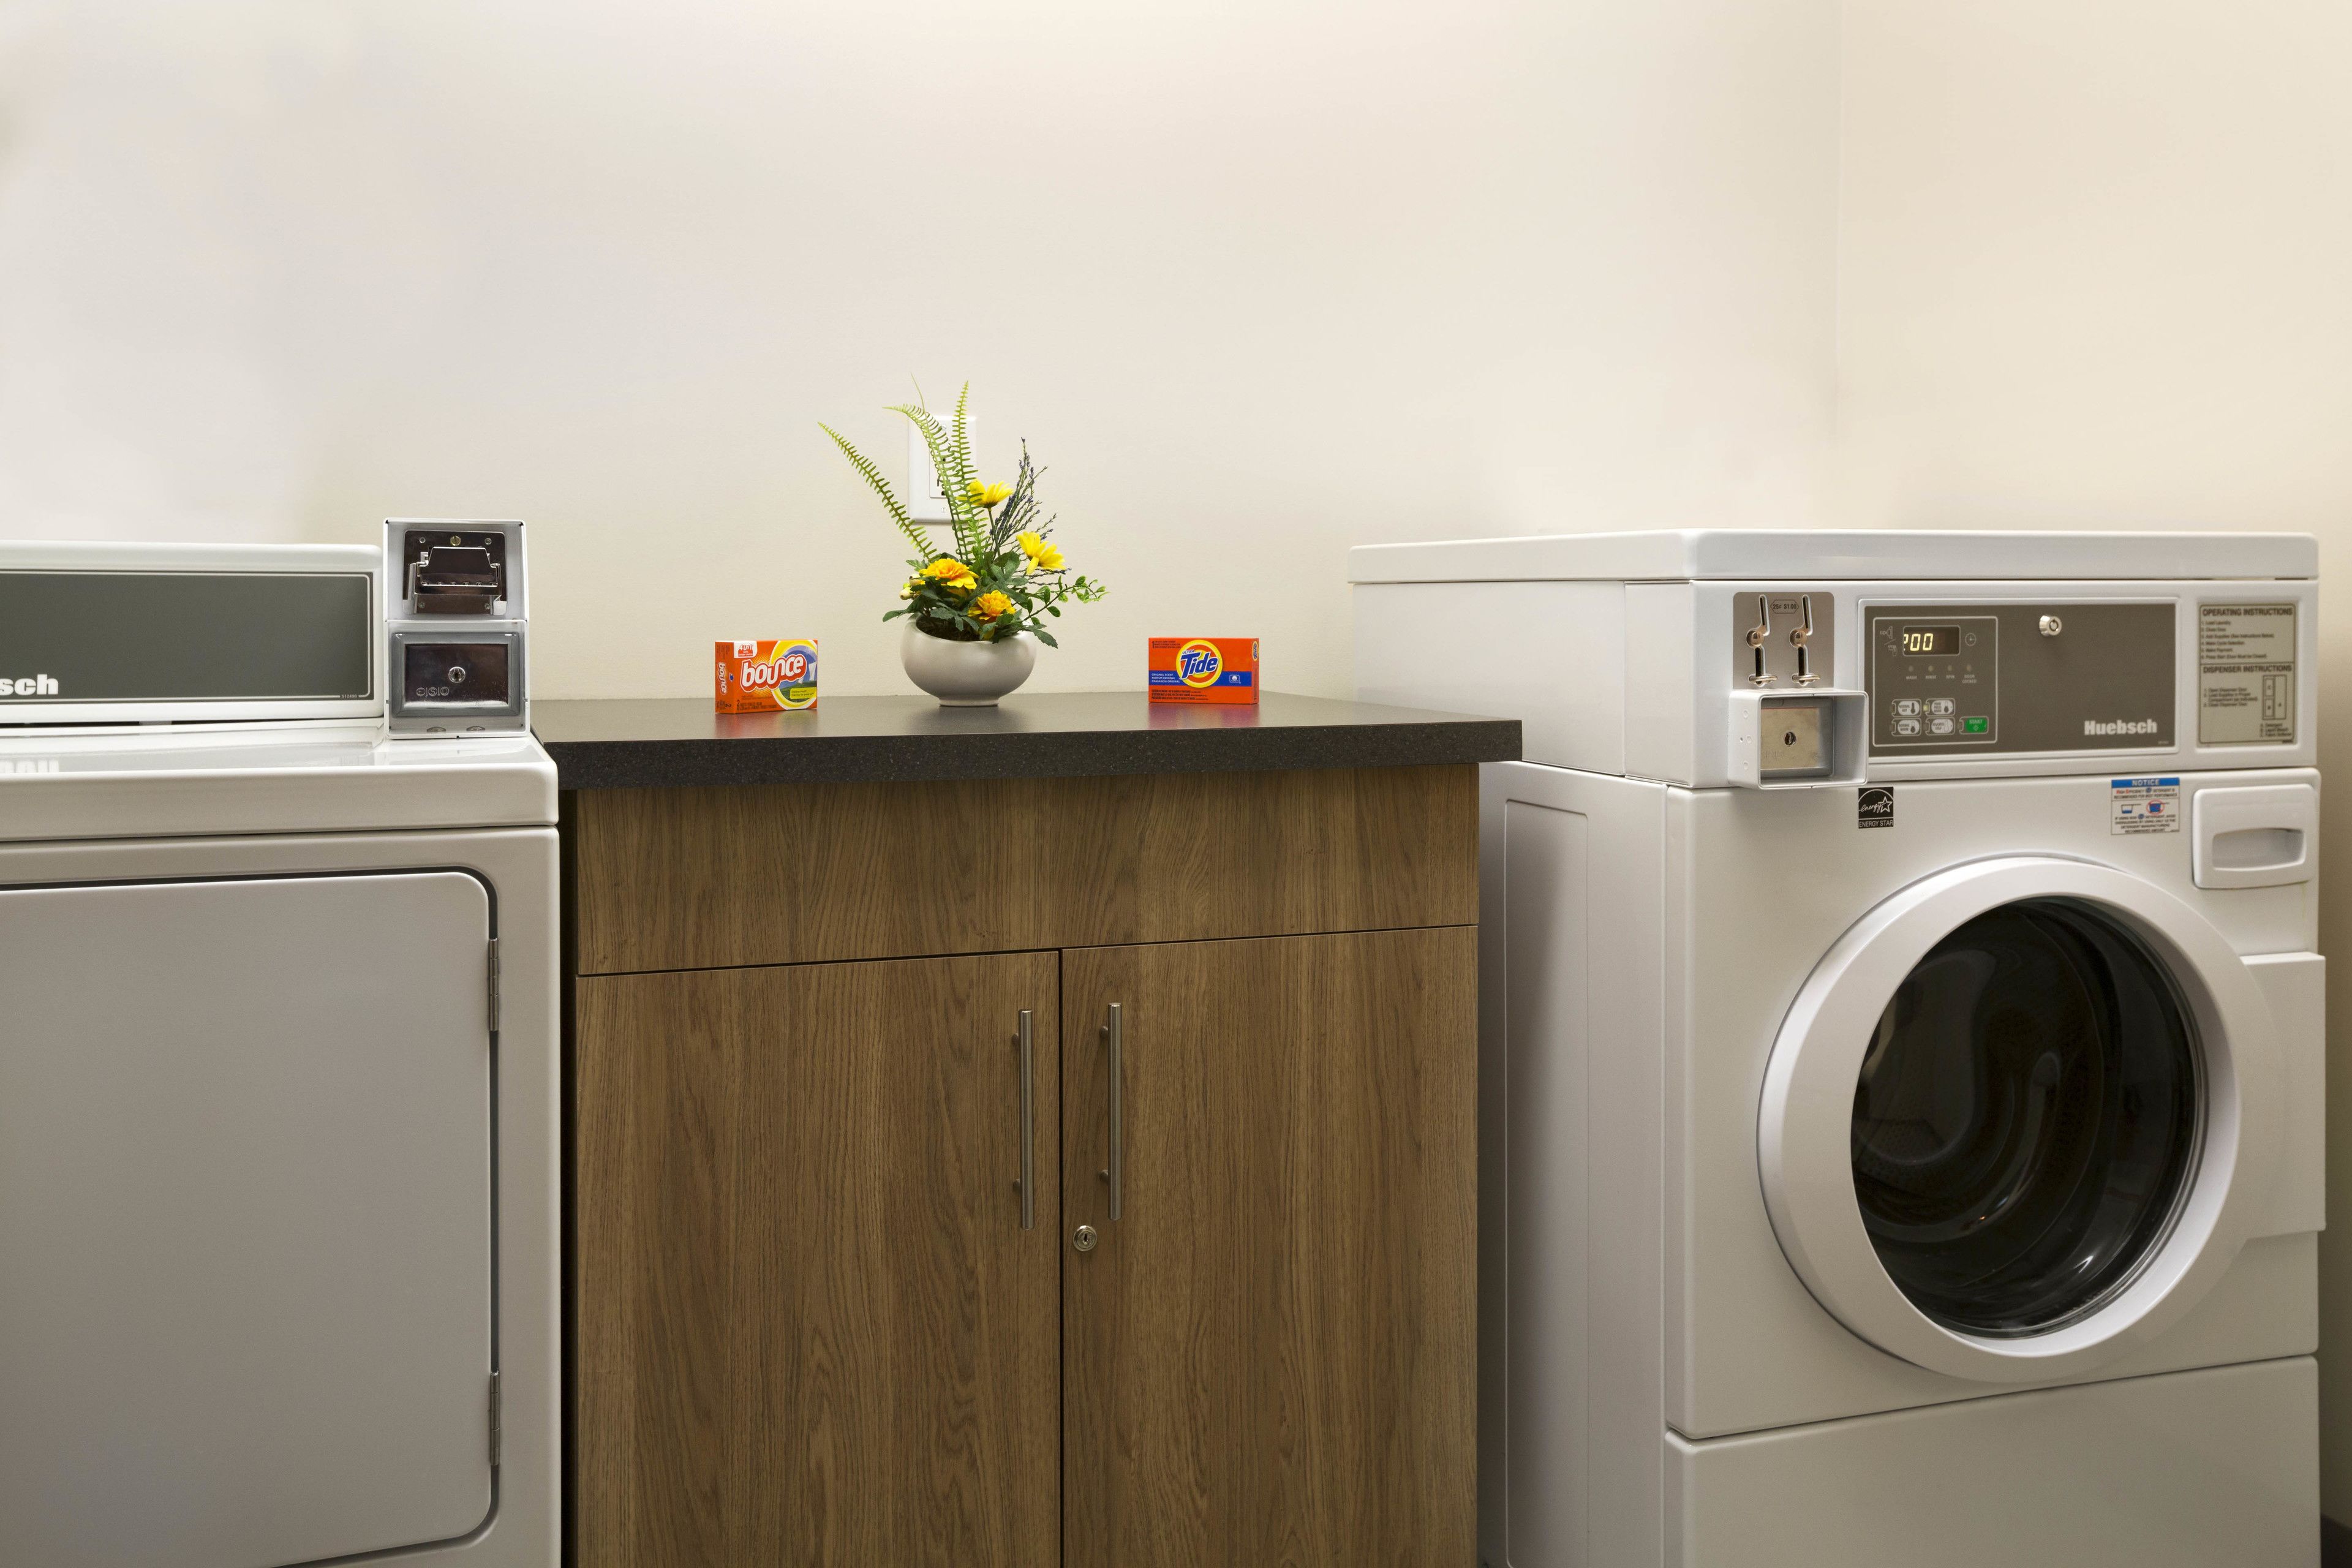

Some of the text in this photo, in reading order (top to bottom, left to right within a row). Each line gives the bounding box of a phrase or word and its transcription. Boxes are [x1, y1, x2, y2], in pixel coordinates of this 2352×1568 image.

[741, 655, 805, 690] bounce
[1180, 652, 1218, 679] Tide
[2084, 718, 2158, 735] Huebsch
